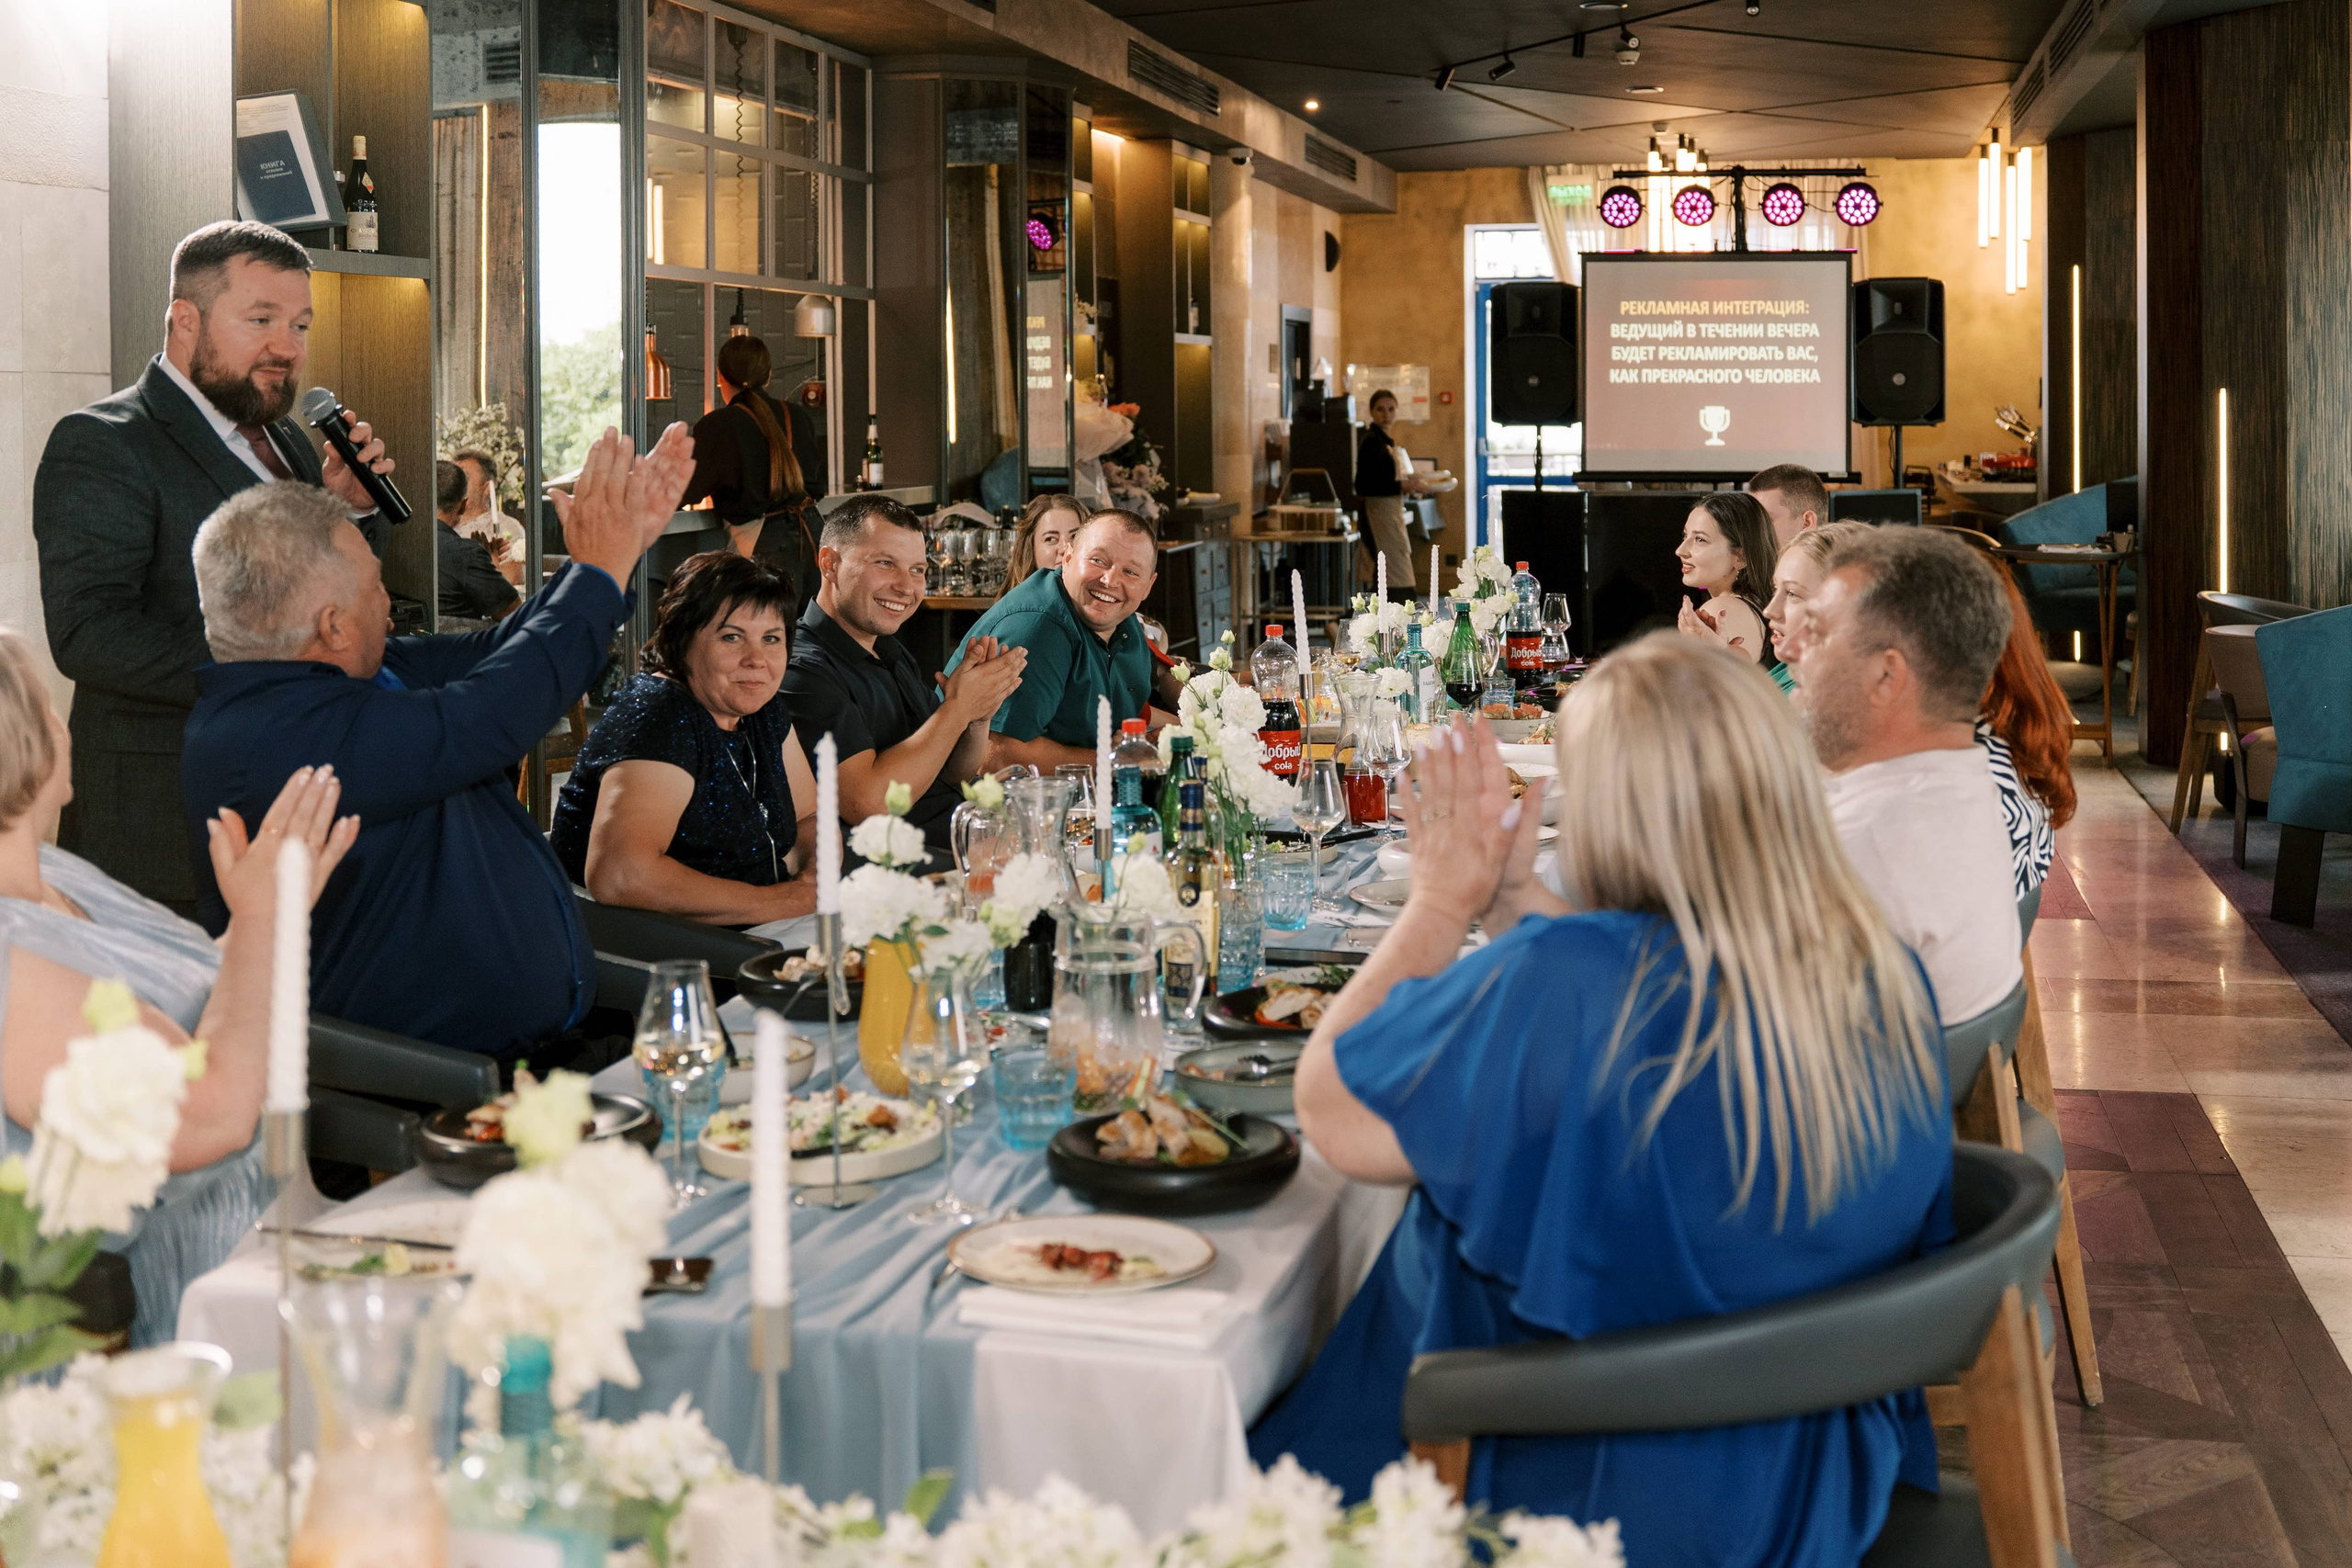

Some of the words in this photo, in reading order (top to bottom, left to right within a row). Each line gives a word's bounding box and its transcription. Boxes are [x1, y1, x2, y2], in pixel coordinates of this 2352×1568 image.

[260, 160, 286, 170] КНИГА
[1620, 300, 1710, 315] РЕКЛАМНАЯ
[1713, 299, 1810, 318] ИНТЕГРАЦИЯ:
[1610, 320, 1684, 342] ВЕДУЩИЙ
[1686, 322, 1697, 338] В
[1699, 322, 1764, 338] ТЕЧЕНИИ
[1767, 322, 1820, 338] ВЕЧЕРА
[1611, 345, 1657, 364] БУДЕТ
[1658, 344, 1784, 361] РЕКЛАМИРОВАТЬ
[1786, 344, 1819, 363] ВАС,
[1609, 368, 1639, 384] КАК
[1641, 367, 1743, 384] ПРЕКРАСНОГО
[1745, 367, 1821, 384] ЧЕЛОВЕКА
[1274, 761, 1292, 769] cola
